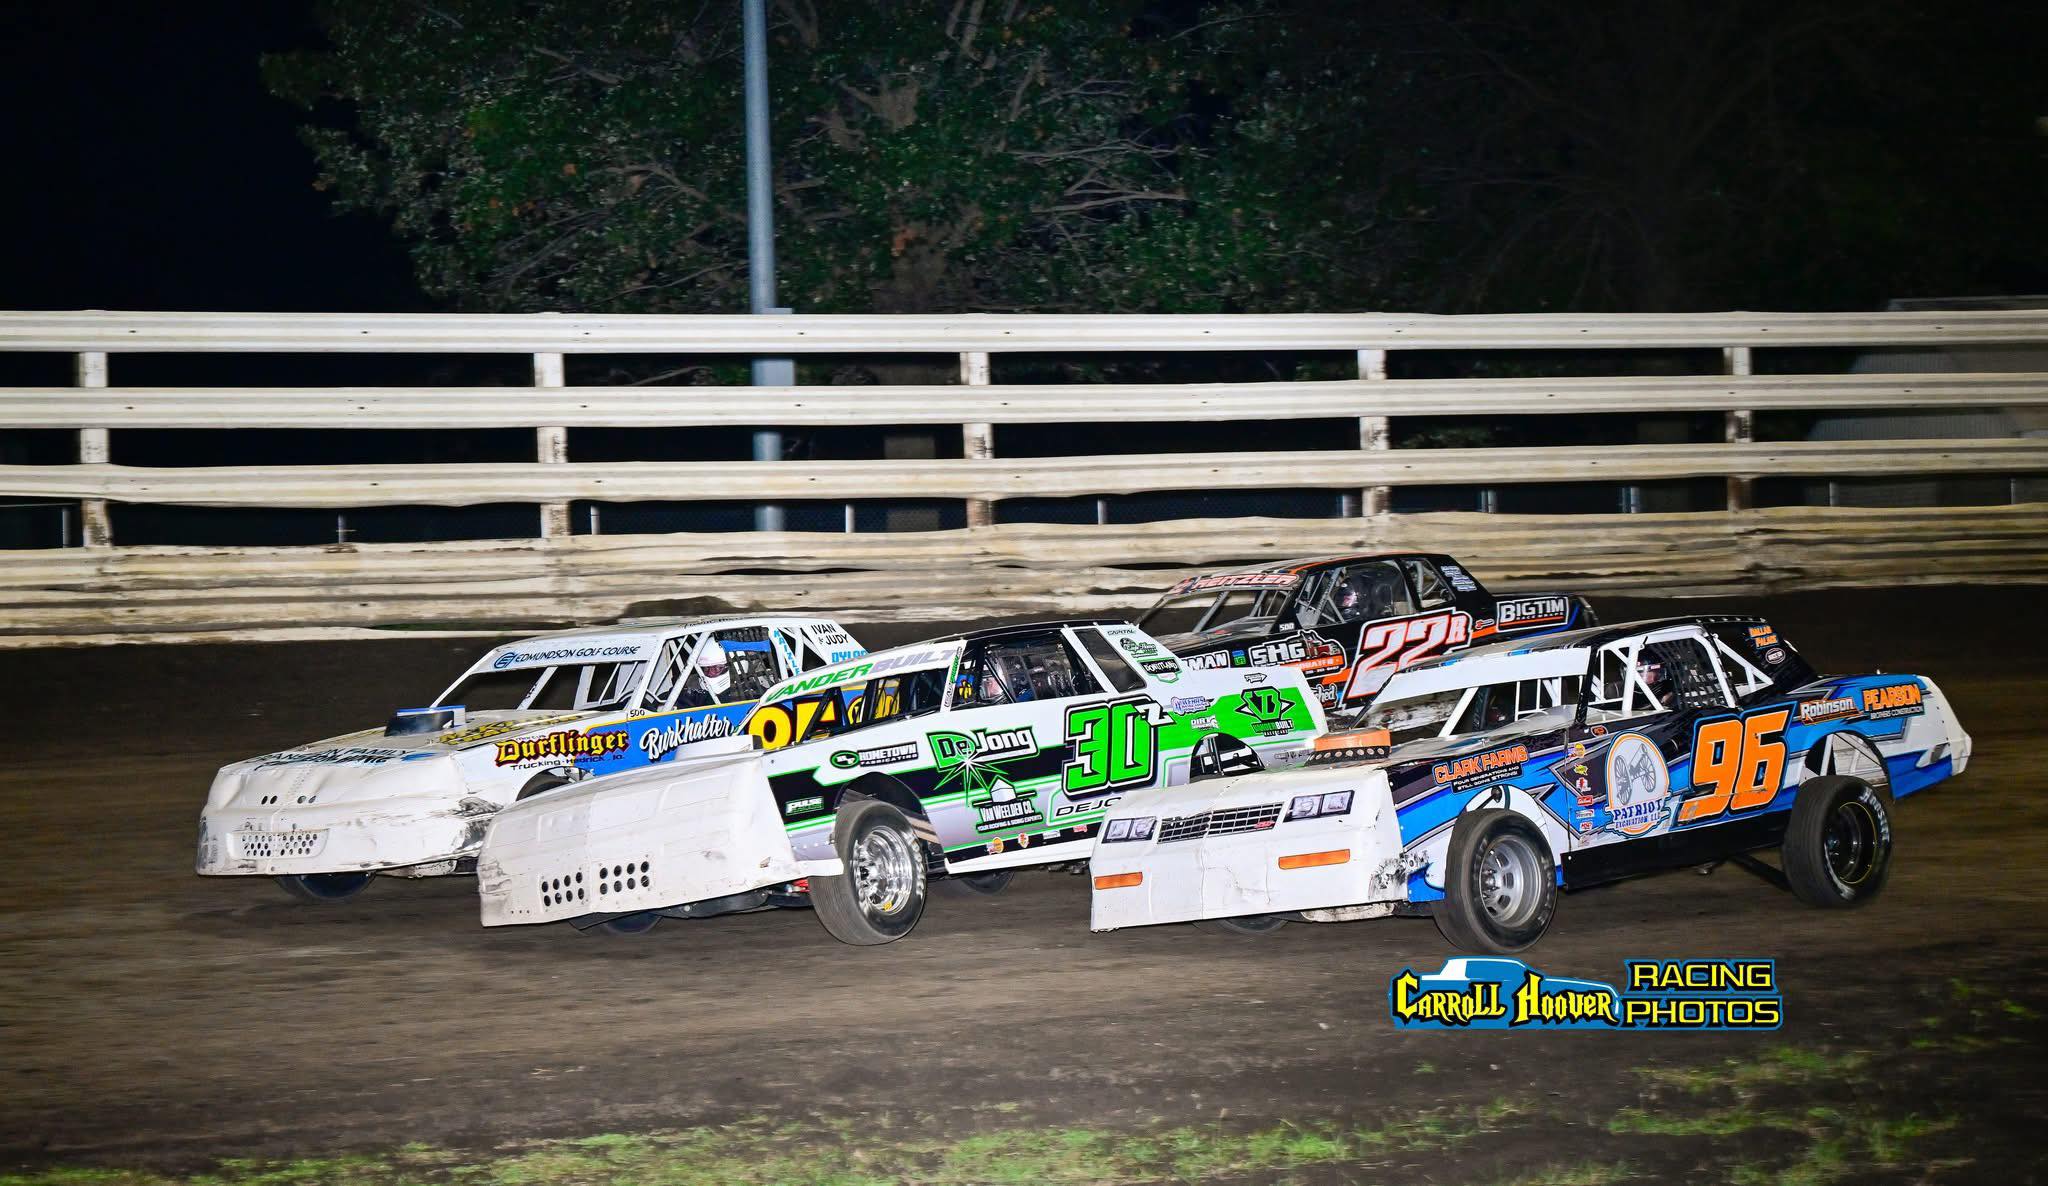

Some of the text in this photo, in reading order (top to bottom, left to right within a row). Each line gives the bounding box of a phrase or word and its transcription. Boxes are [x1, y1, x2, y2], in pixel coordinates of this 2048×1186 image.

[811, 623, 837, 635] IVAN
[825, 633, 849, 646] JUDY
[515, 645, 641, 662] EDMUNDSON GOLF COURSE
[1252, 642, 1306, 665] SHG
[1863, 684, 1921, 711] PEARSON
[629, 709, 646, 718] 500
[1800, 698, 1855, 721] Robinson
[498, 730, 628, 763] Durflinger
[639, 713, 733, 760] Burkhalter
[937, 728, 1038, 762] DeJong
[1434, 745, 1529, 784] CLARK FARMS
[1678, 709, 1790, 822] 96
[1613, 798, 1663, 821] PATRIOT
